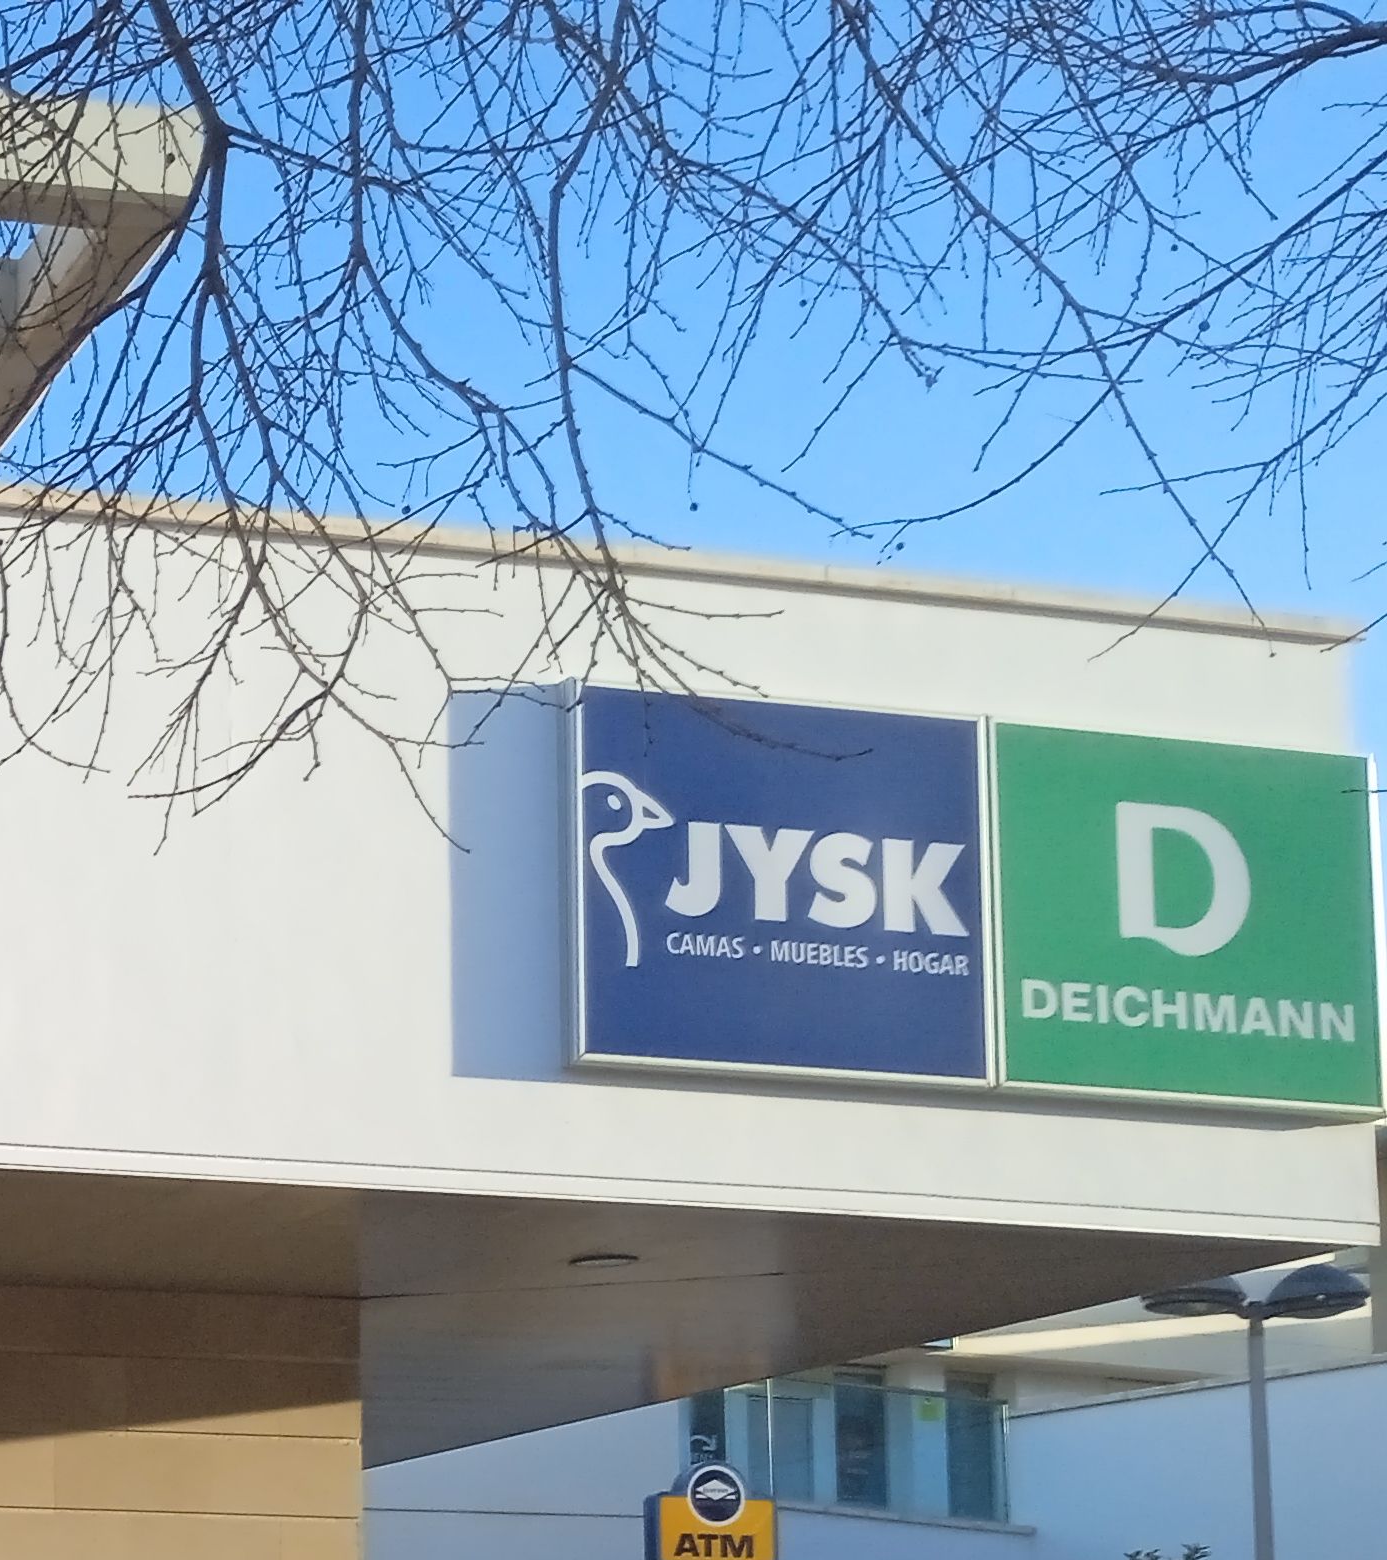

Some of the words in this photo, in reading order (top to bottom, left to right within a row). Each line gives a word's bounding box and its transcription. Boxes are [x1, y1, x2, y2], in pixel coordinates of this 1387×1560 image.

[665, 820, 969, 937] JYSK
[666, 932, 744, 959] CAMAS
[770, 940, 869, 969] MUEBLES
[893, 949, 969, 977] HOGAR
[1020, 978, 1356, 1043] DEICHMANN
[673, 1533, 754, 1559] ATM
